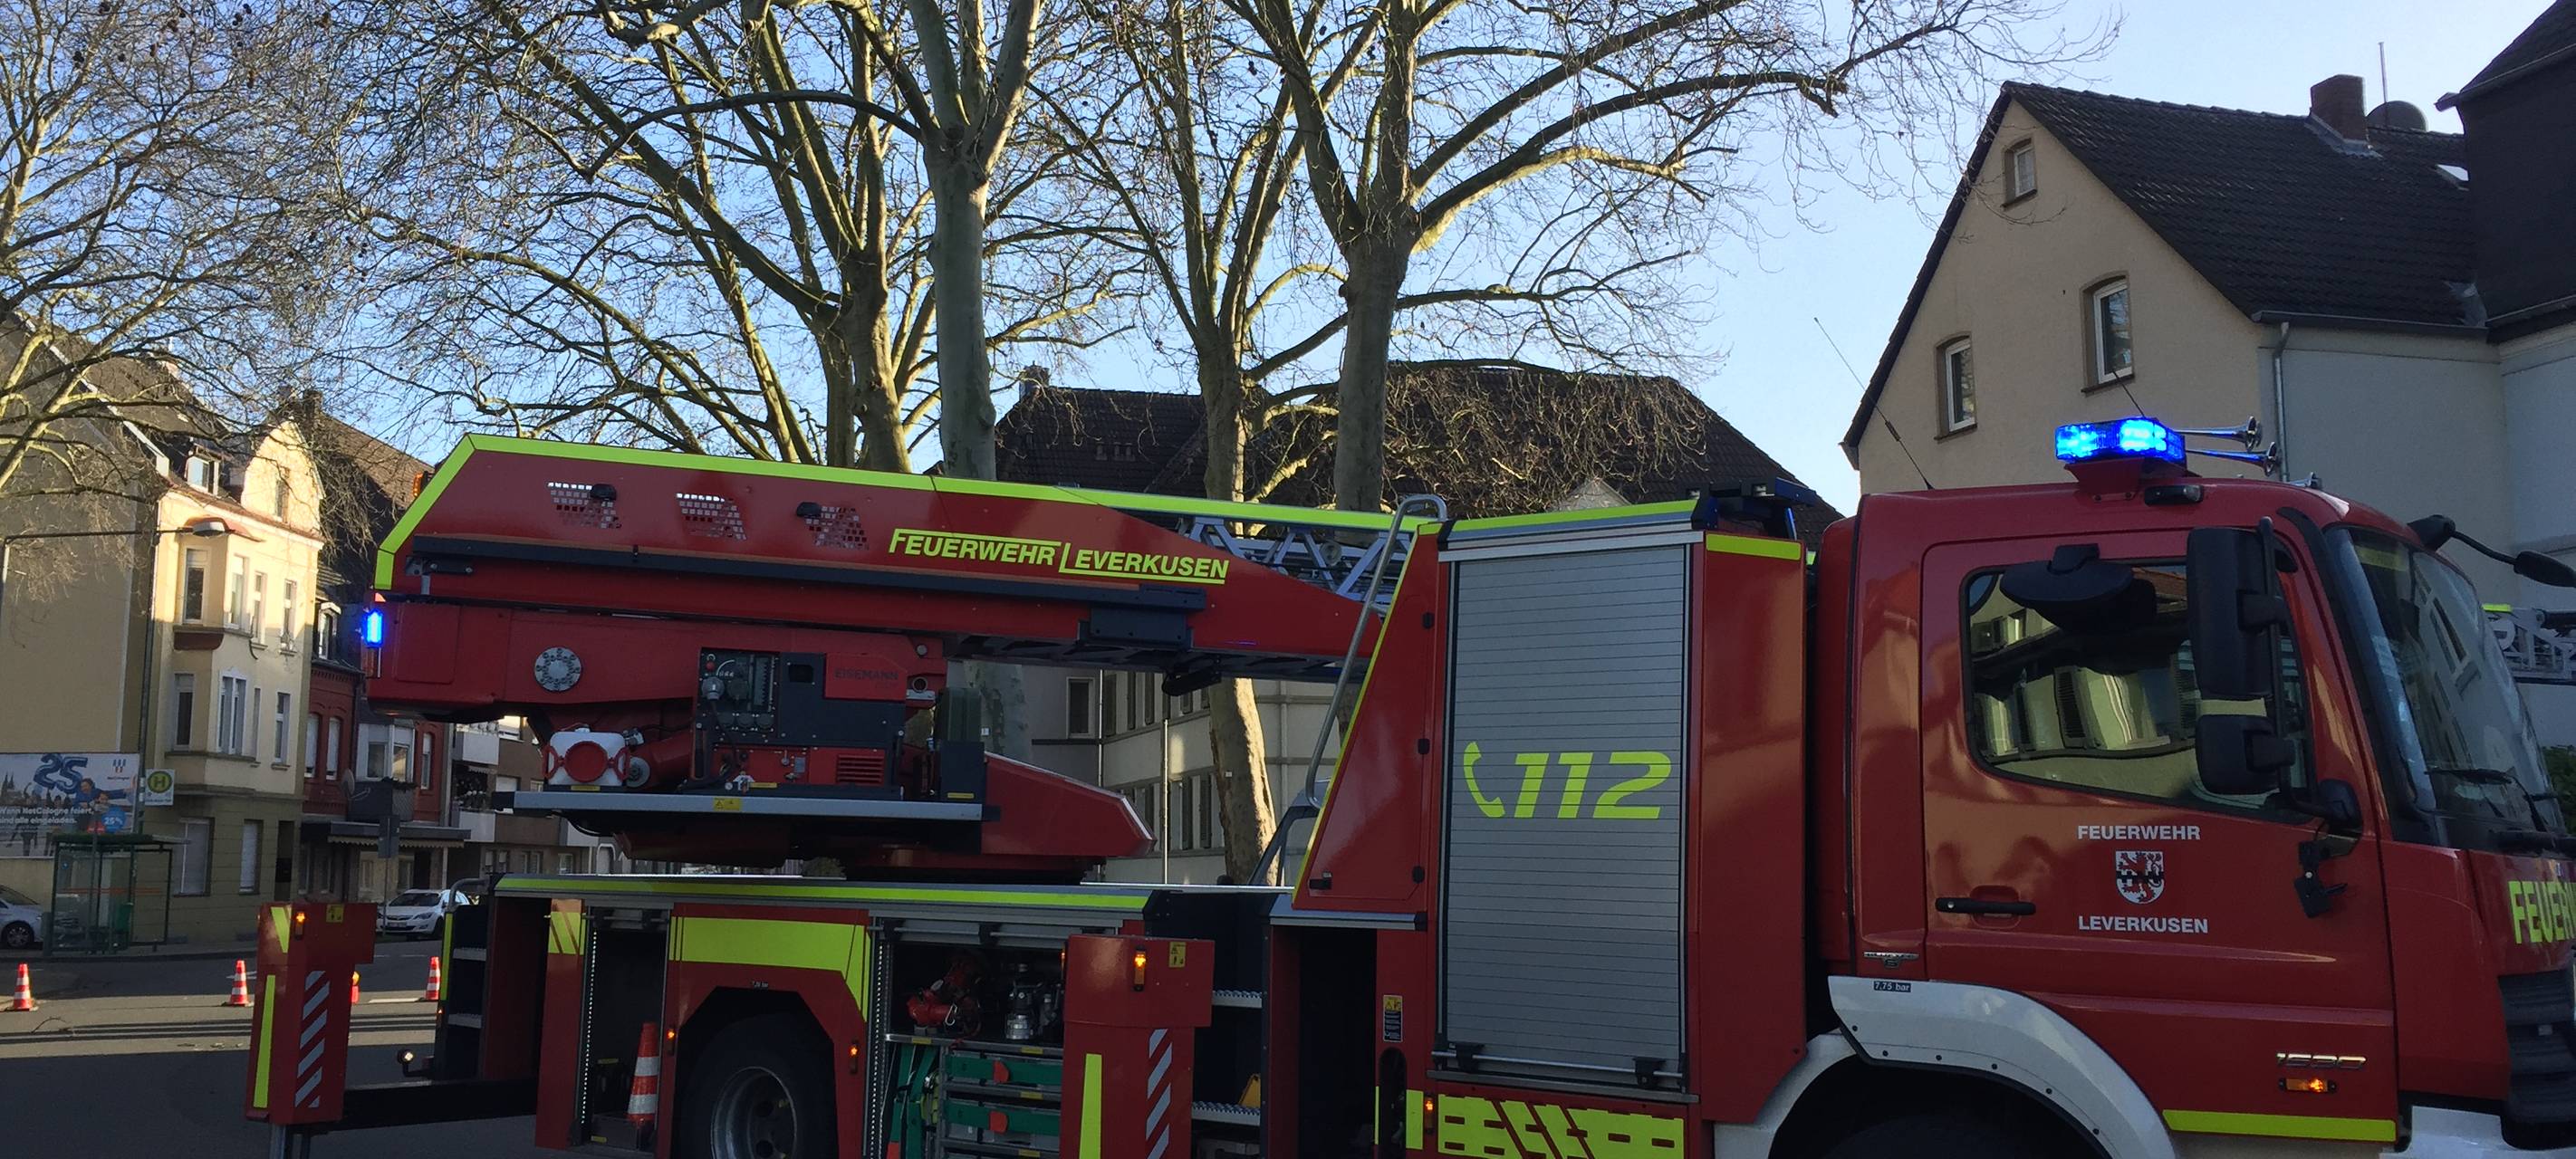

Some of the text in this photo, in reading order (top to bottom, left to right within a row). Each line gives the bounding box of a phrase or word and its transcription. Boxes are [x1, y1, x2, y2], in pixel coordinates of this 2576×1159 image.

[889, 528, 1229, 585] FEUERWEHR LEVERKUSEN
[34, 752, 88, 793] 25
[153, 775, 167, 788] H
[1514, 752, 1671, 819] 112
[2077, 825, 2201, 840] FEUERWEHR
[2078, 915, 2208, 933] LEVERKUSEN
[1895, 982, 1909, 991] bar
